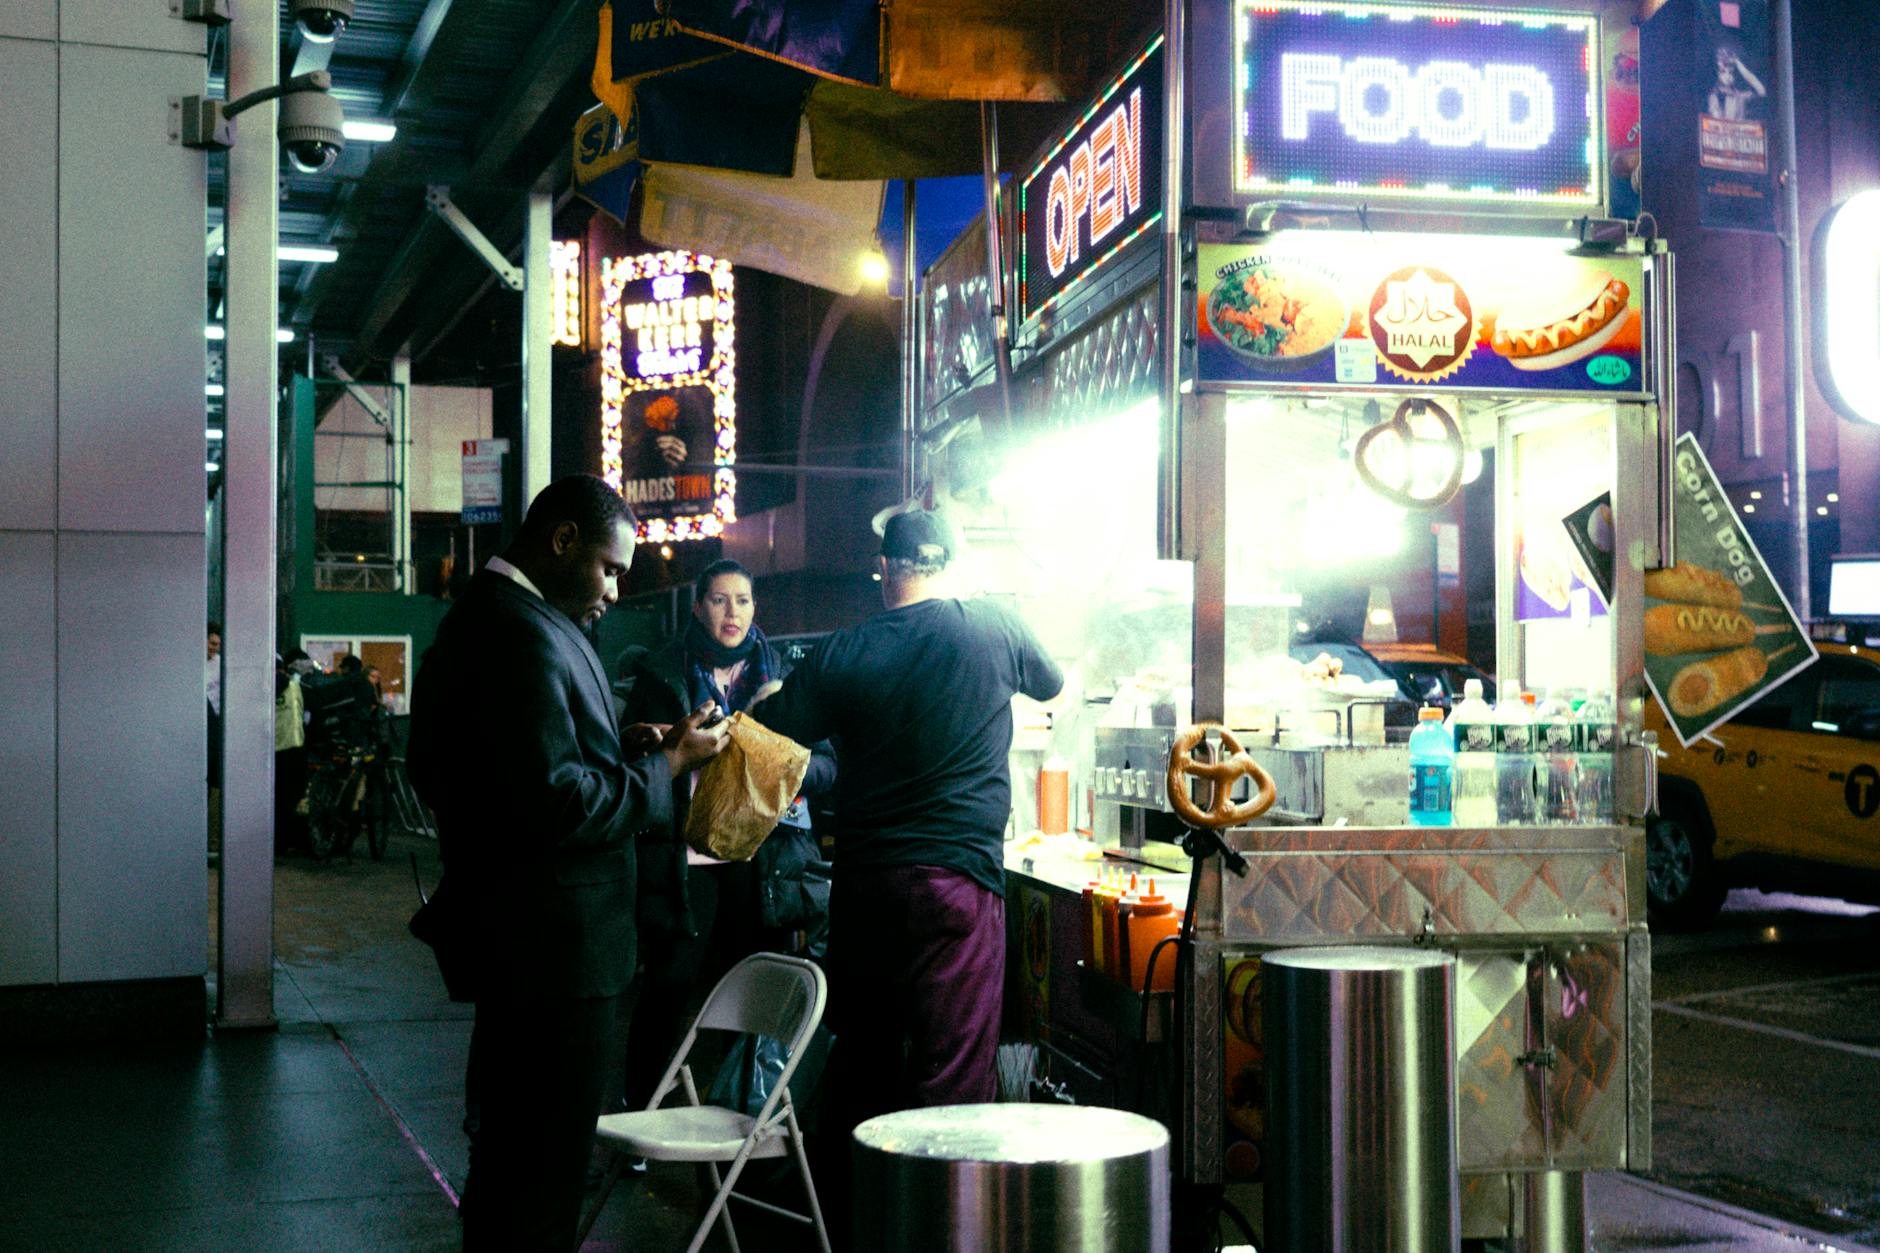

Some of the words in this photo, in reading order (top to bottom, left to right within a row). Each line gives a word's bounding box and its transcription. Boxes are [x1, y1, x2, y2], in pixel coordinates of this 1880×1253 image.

[1281, 52, 1555, 151] FOOD
[1046, 86, 1142, 279] OPEN
[1392, 333, 1453, 348] HALAL
[624, 474, 711, 504] HADESTOWN
[1677, 451, 1719, 523] Corn
[1716, 524, 1755, 588] Dog
[1854, 776, 1875, 813] T
